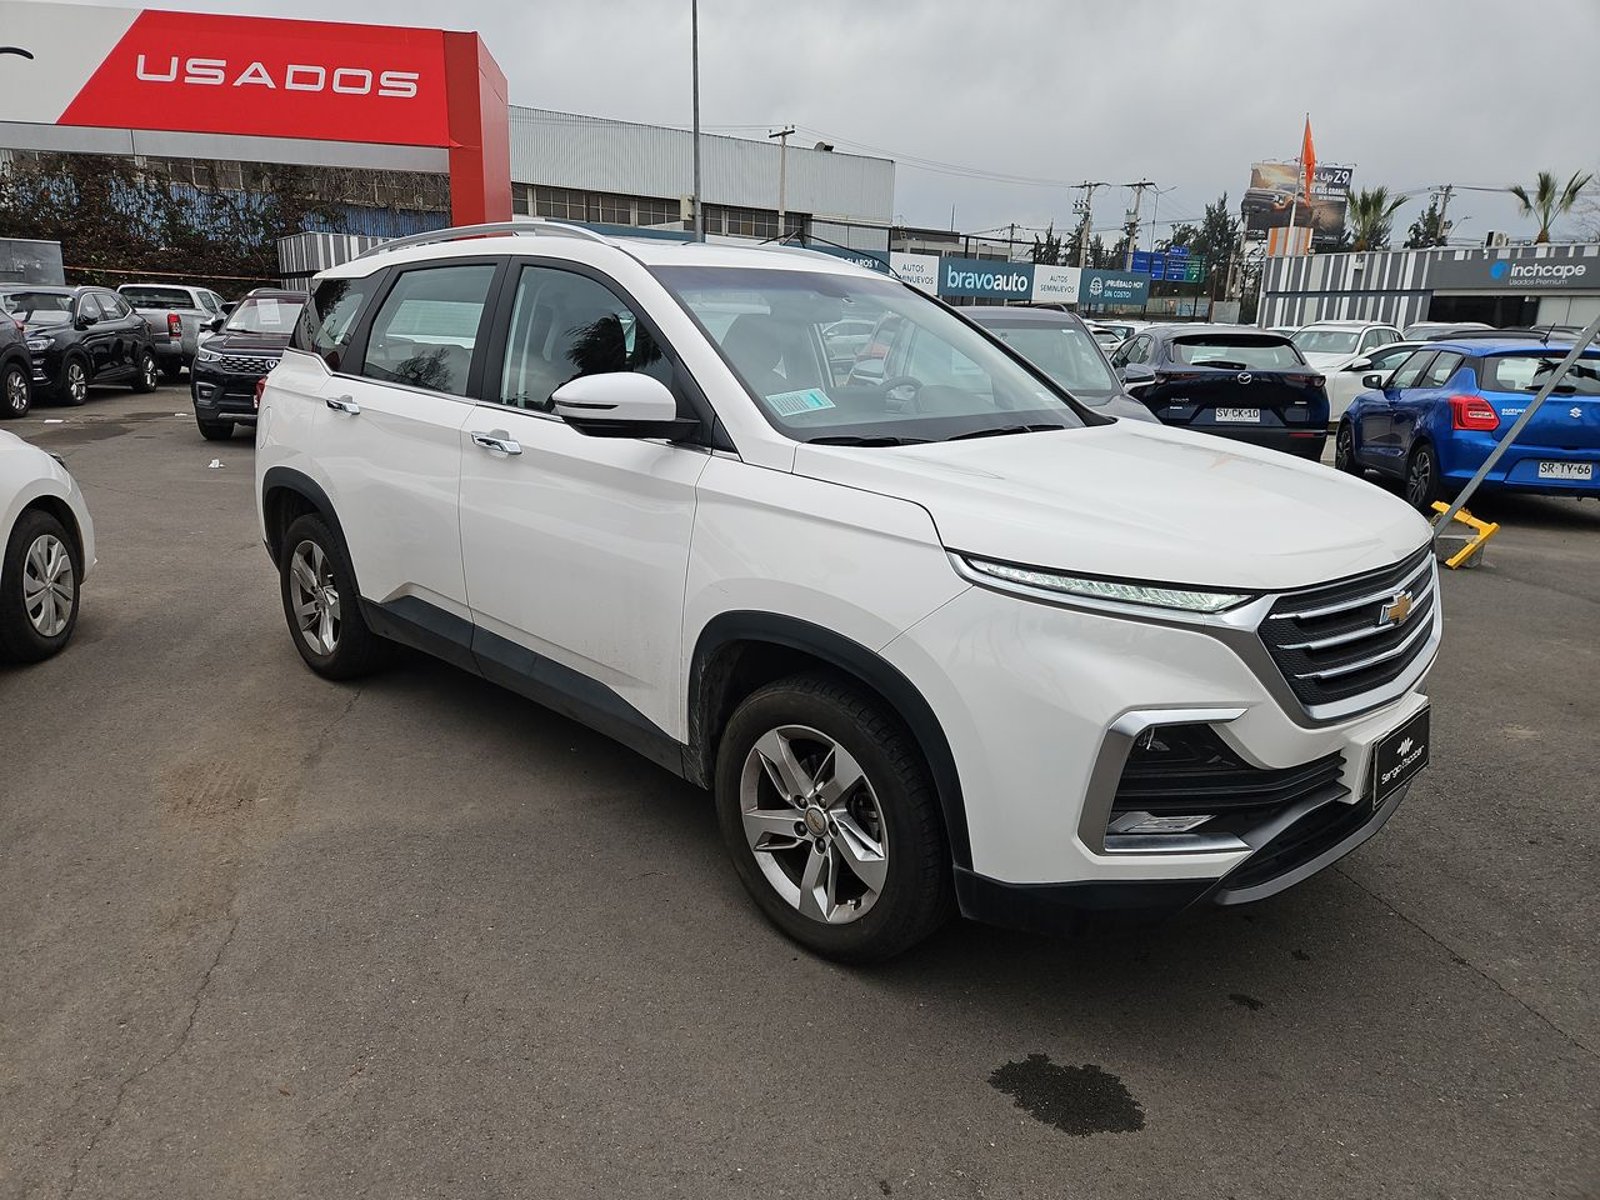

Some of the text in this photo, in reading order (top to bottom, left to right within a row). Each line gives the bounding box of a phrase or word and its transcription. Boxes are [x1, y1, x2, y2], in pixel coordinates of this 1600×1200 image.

[136, 54, 420, 98] USADOS
[1333, 169, 1351, 184] Z9
[902, 263, 925, 273] AUTOS
[1510, 263, 1586, 279] inchcape
[946, 265, 1029, 292] bravoauto
[1050, 275, 1068, 283] AUTOS
[1535, 278, 1568, 286] Premium
[1040, 284, 1075, 294] SEMINUEVOS
